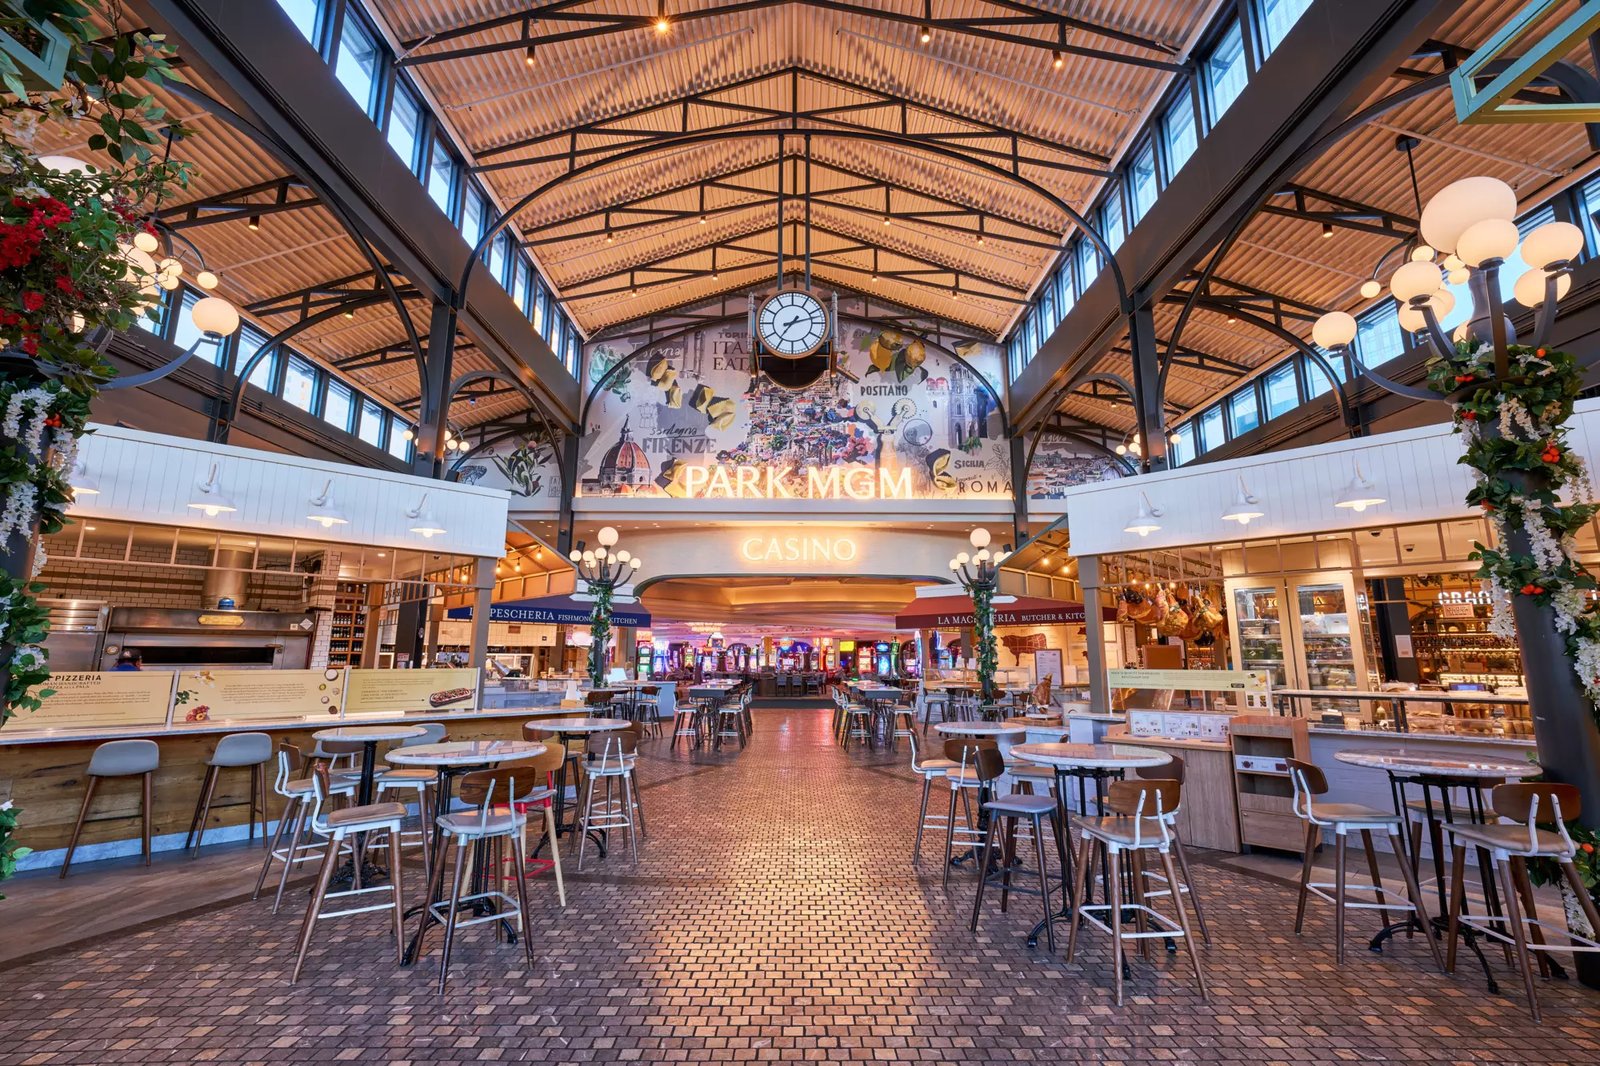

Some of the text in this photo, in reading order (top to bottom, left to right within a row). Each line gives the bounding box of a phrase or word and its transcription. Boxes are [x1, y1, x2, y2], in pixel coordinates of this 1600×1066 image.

[860, 385, 908, 396] POSITANO
[643, 438, 717, 454] FIRENZE
[685, 466, 913, 499] PARK MGM
[959, 480, 1013, 493] ROMA
[742, 537, 857, 561] CASINO
[490, 608, 554, 620] PESCHERIA
[938, 616, 950, 625] LA
[1021, 614, 1056, 622] BUTCHER
[1065, 612, 1085, 620] KITC
